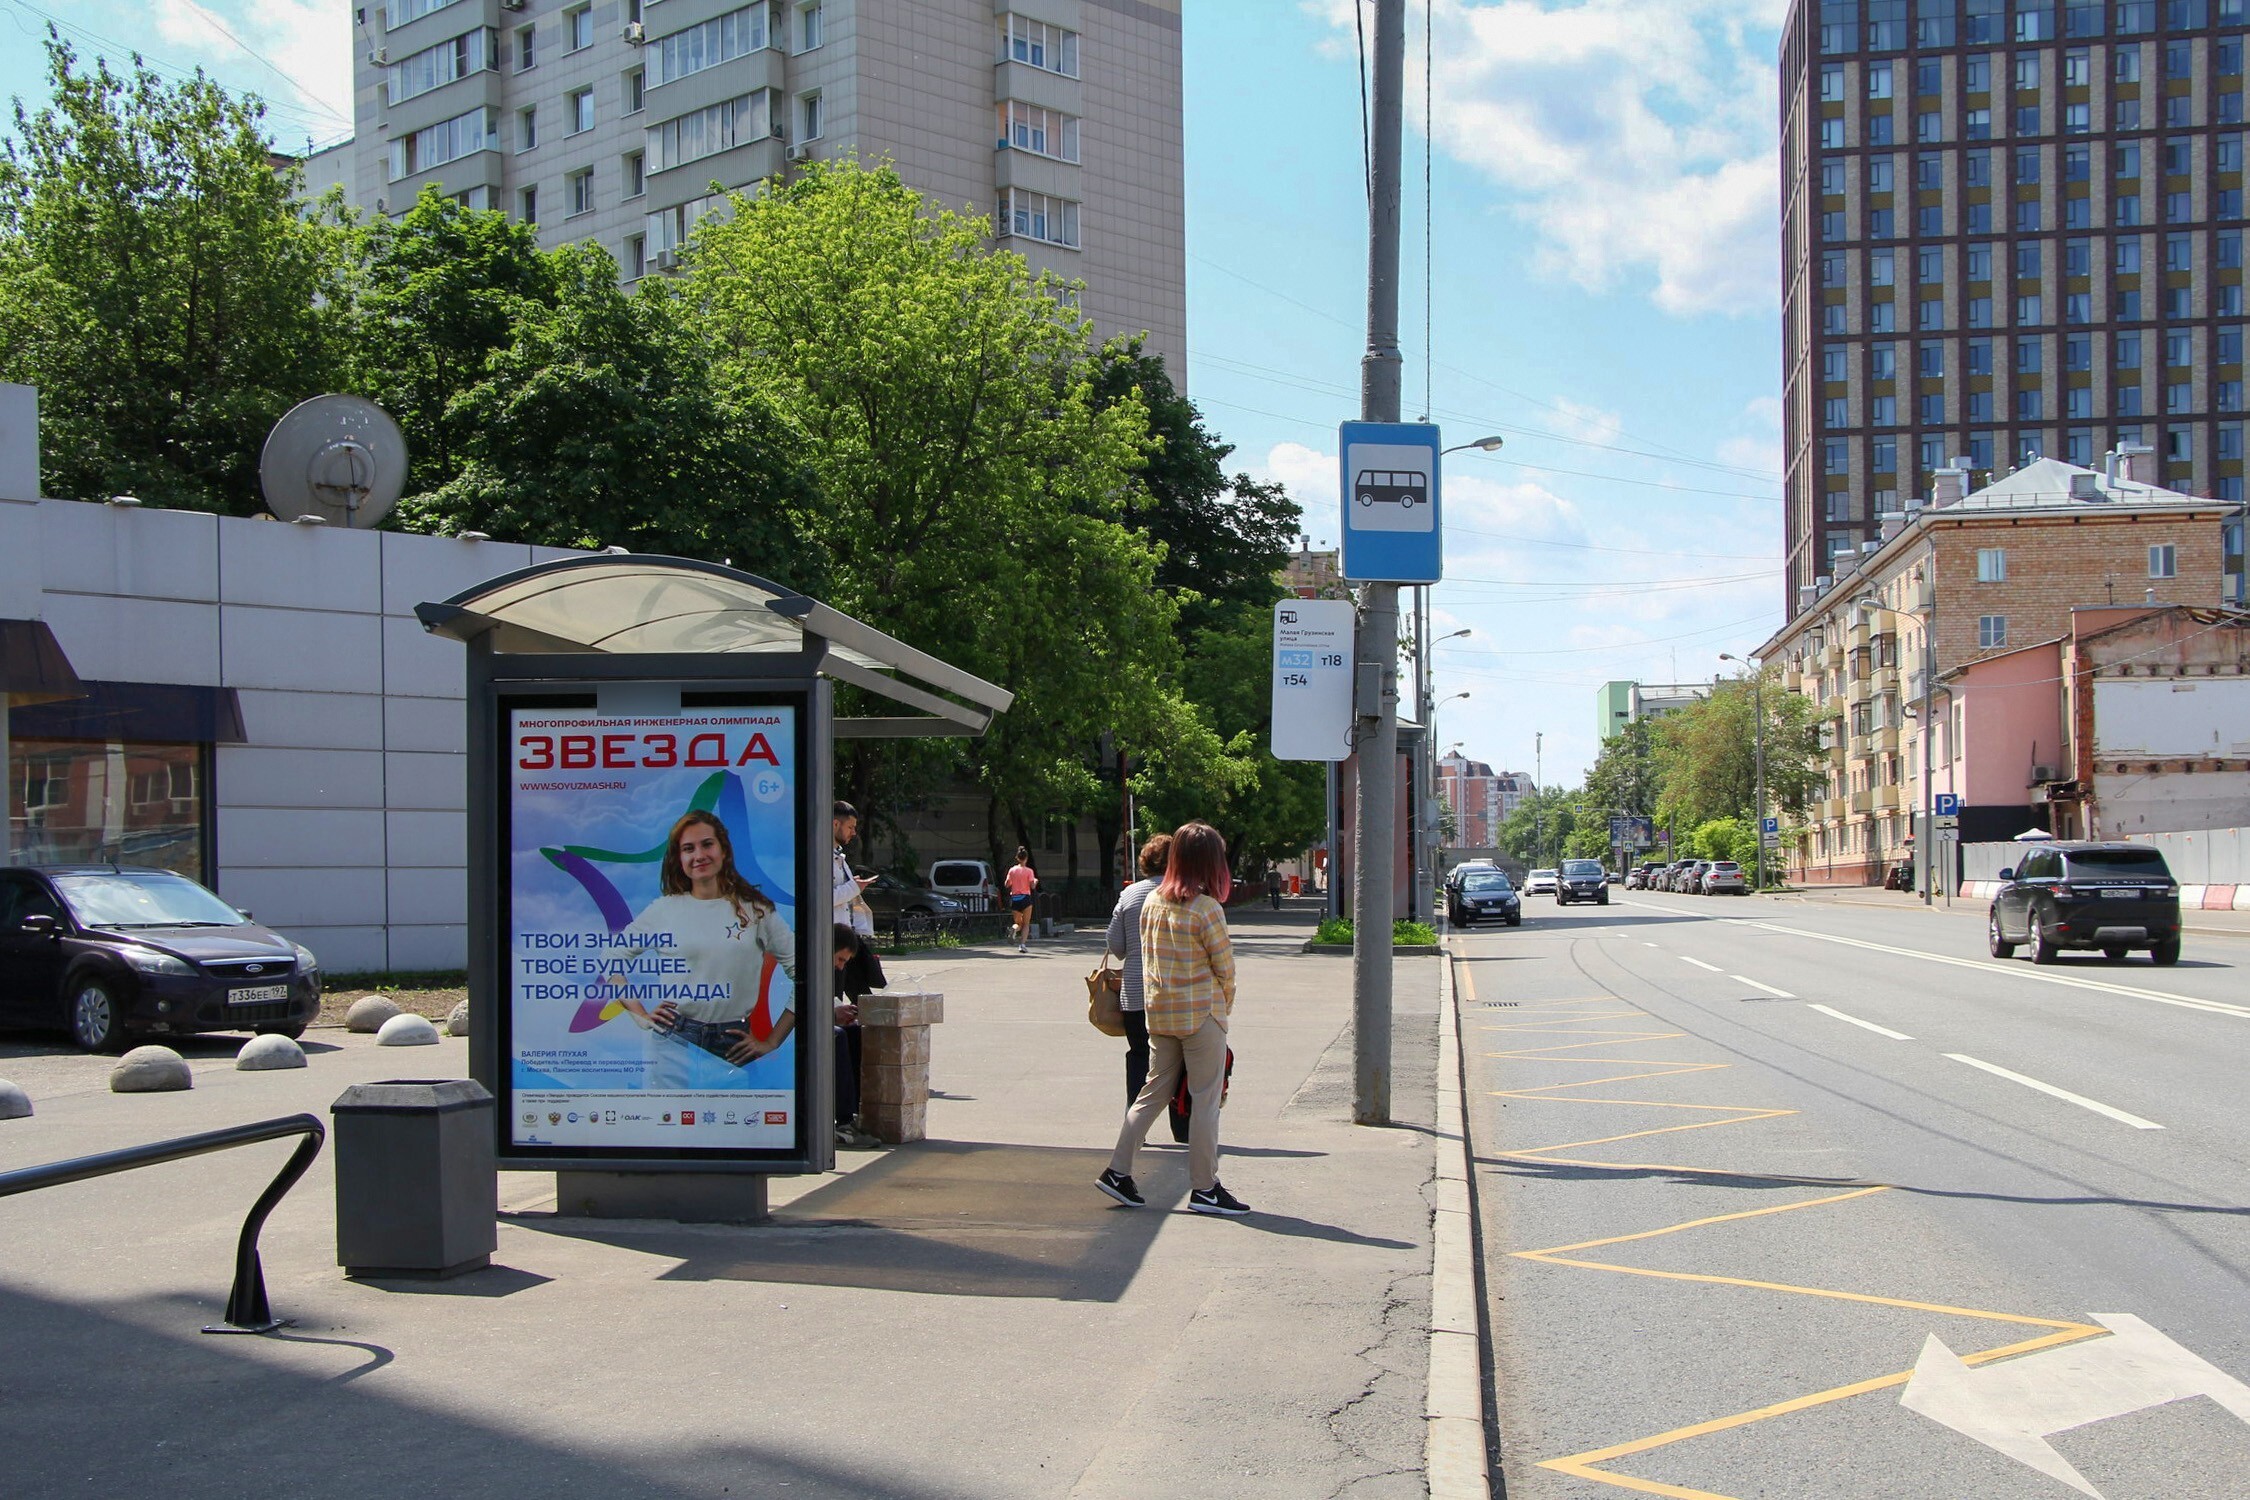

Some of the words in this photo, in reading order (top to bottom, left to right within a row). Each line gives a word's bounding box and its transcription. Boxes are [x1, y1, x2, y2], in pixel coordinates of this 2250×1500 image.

[1301, 629, 1335, 637] Грузинская
[519, 718, 631, 728] МНОГОПРОФИЛЬНАЯ
[634, 717, 708, 727] ИНЖЕНЕРНАЯ
[710, 716, 781, 726] ОЛИМПИАДА
[519, 732, 781, 769] ЗВЕЗДА
[520, 781, 627, 791] WWW.SOYUZMASH.RU
[758, 779, 780, 795] 6+
[521, 933, 579, 949] ТВОИ
[584, 932, 678, 948] ЗНАНИЯ.
[521, 955, 578, 974] ТВОЁ
[584, 958, 692, 976] БУДУЩЕЕ.
[521, 984, 578, 1000] ТВОЯ
[584, 982, 731, 1000] ОЛИМПИАДА!
[521, 1050, 557, 1058] ВАЛЕРИЯ
[558, 1050, 588, 1058] ГЛУХАЯ
